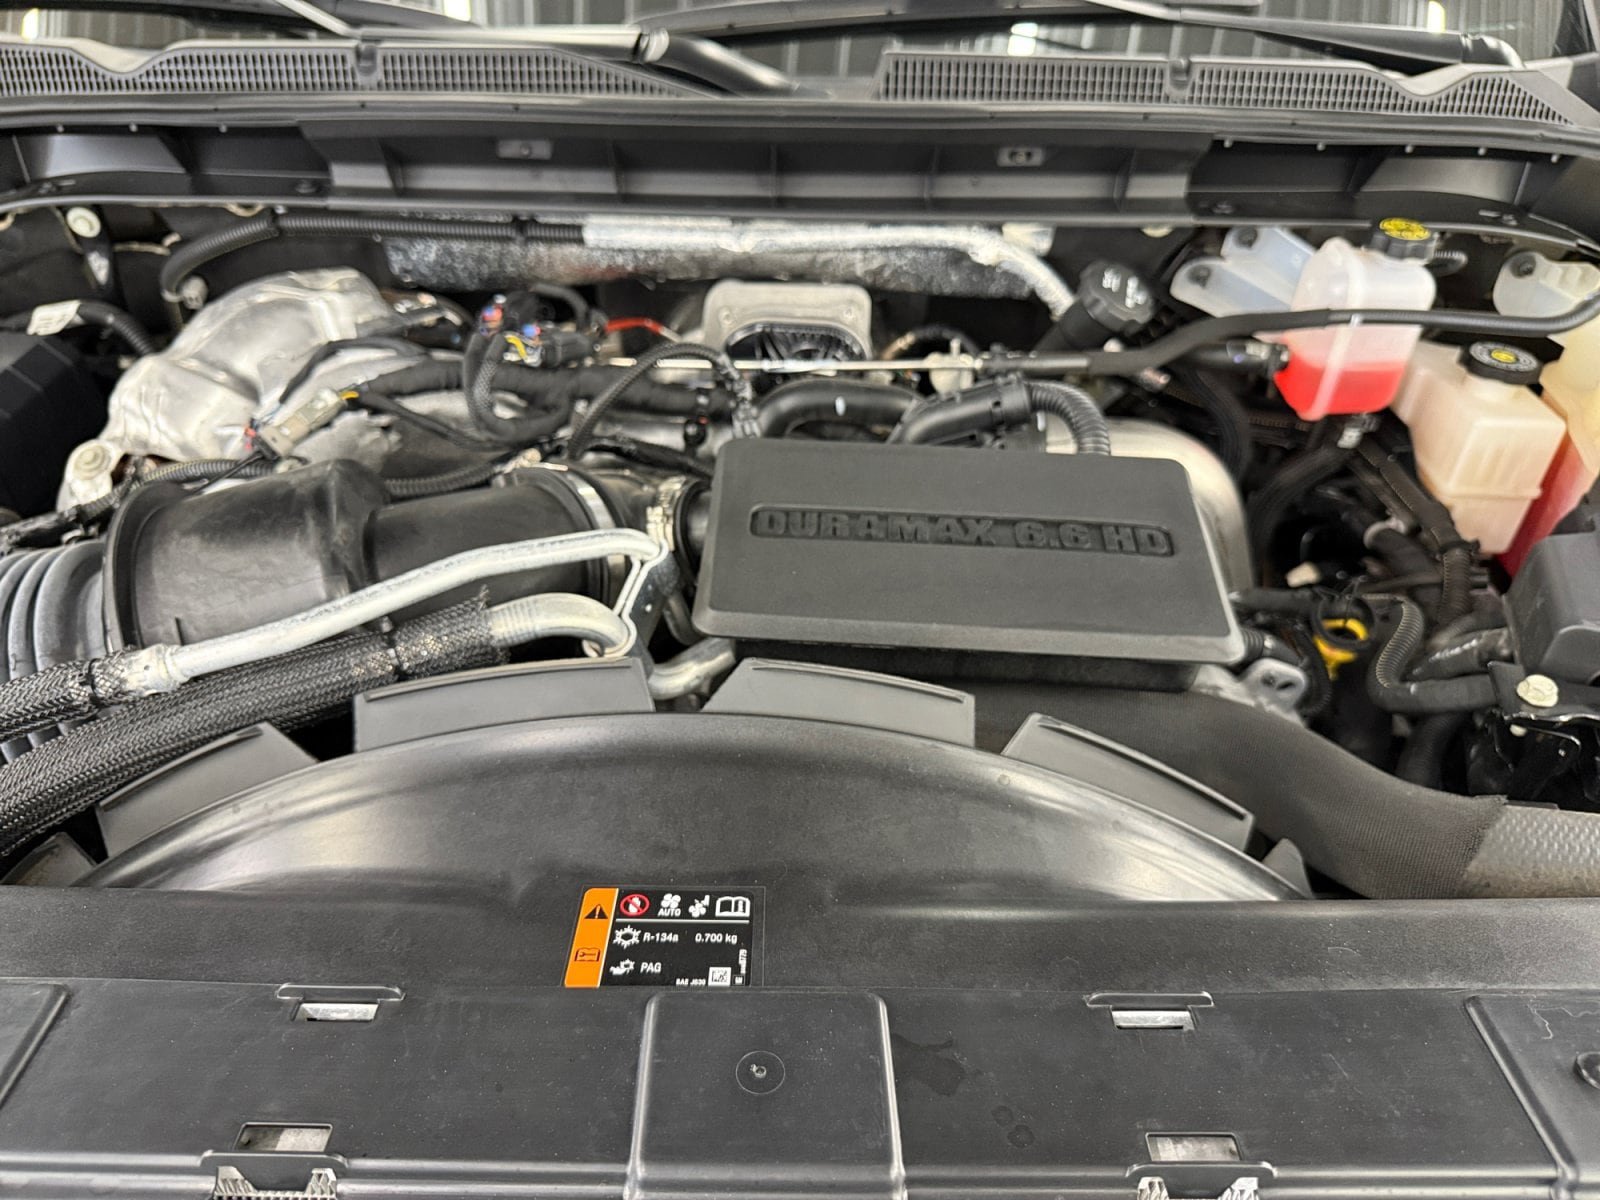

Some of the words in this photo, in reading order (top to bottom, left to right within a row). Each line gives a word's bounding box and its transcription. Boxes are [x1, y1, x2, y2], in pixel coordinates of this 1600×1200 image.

[756, 509, 996, 545] DURAMAX
[1014, 520, 1092, 550] 6.6
[1101, 524, 1170, 555] HD
[657, 908, 682, 917] AUTO
[643, 932, 679, 943] R-134a
[695, 932, 723, 943] 0.700
[725, 932, 738, 945] kg
[640, 962, 662, 973] PAG
